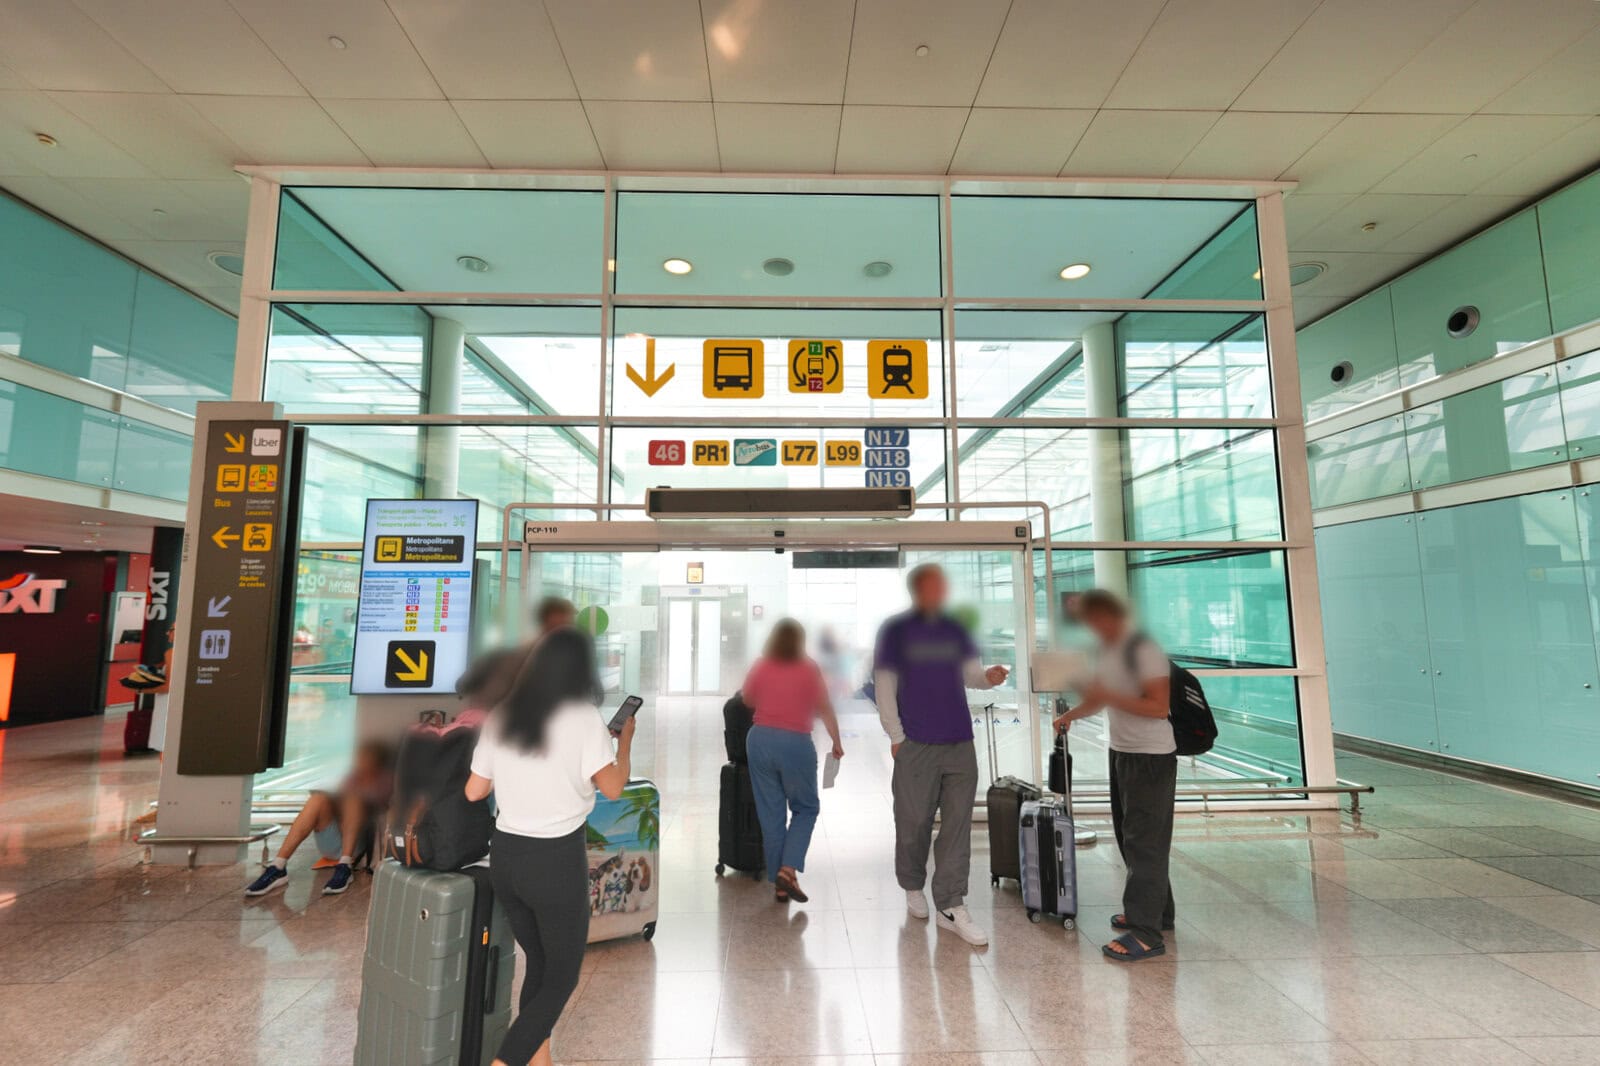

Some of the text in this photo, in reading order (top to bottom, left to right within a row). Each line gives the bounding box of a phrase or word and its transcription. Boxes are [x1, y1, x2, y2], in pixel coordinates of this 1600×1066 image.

[810, 344, 822, 353] T1
[810, 380, 822, 390] T2
[254, 437, 278, 447] Uber
[868, 430, 905, 446] N17
[656, 444, 680, 461] 46
[695, 444, 728, 462] PR1
[784, 445, 816, 462] L77
[827, 445, 858, 461] L99
[868, 450, 906, 466] N18
[868, 471, 906, 487] N19
[406, 537, 454, 546] Metropolitans
[146, 567, 170, 620] SIXT
